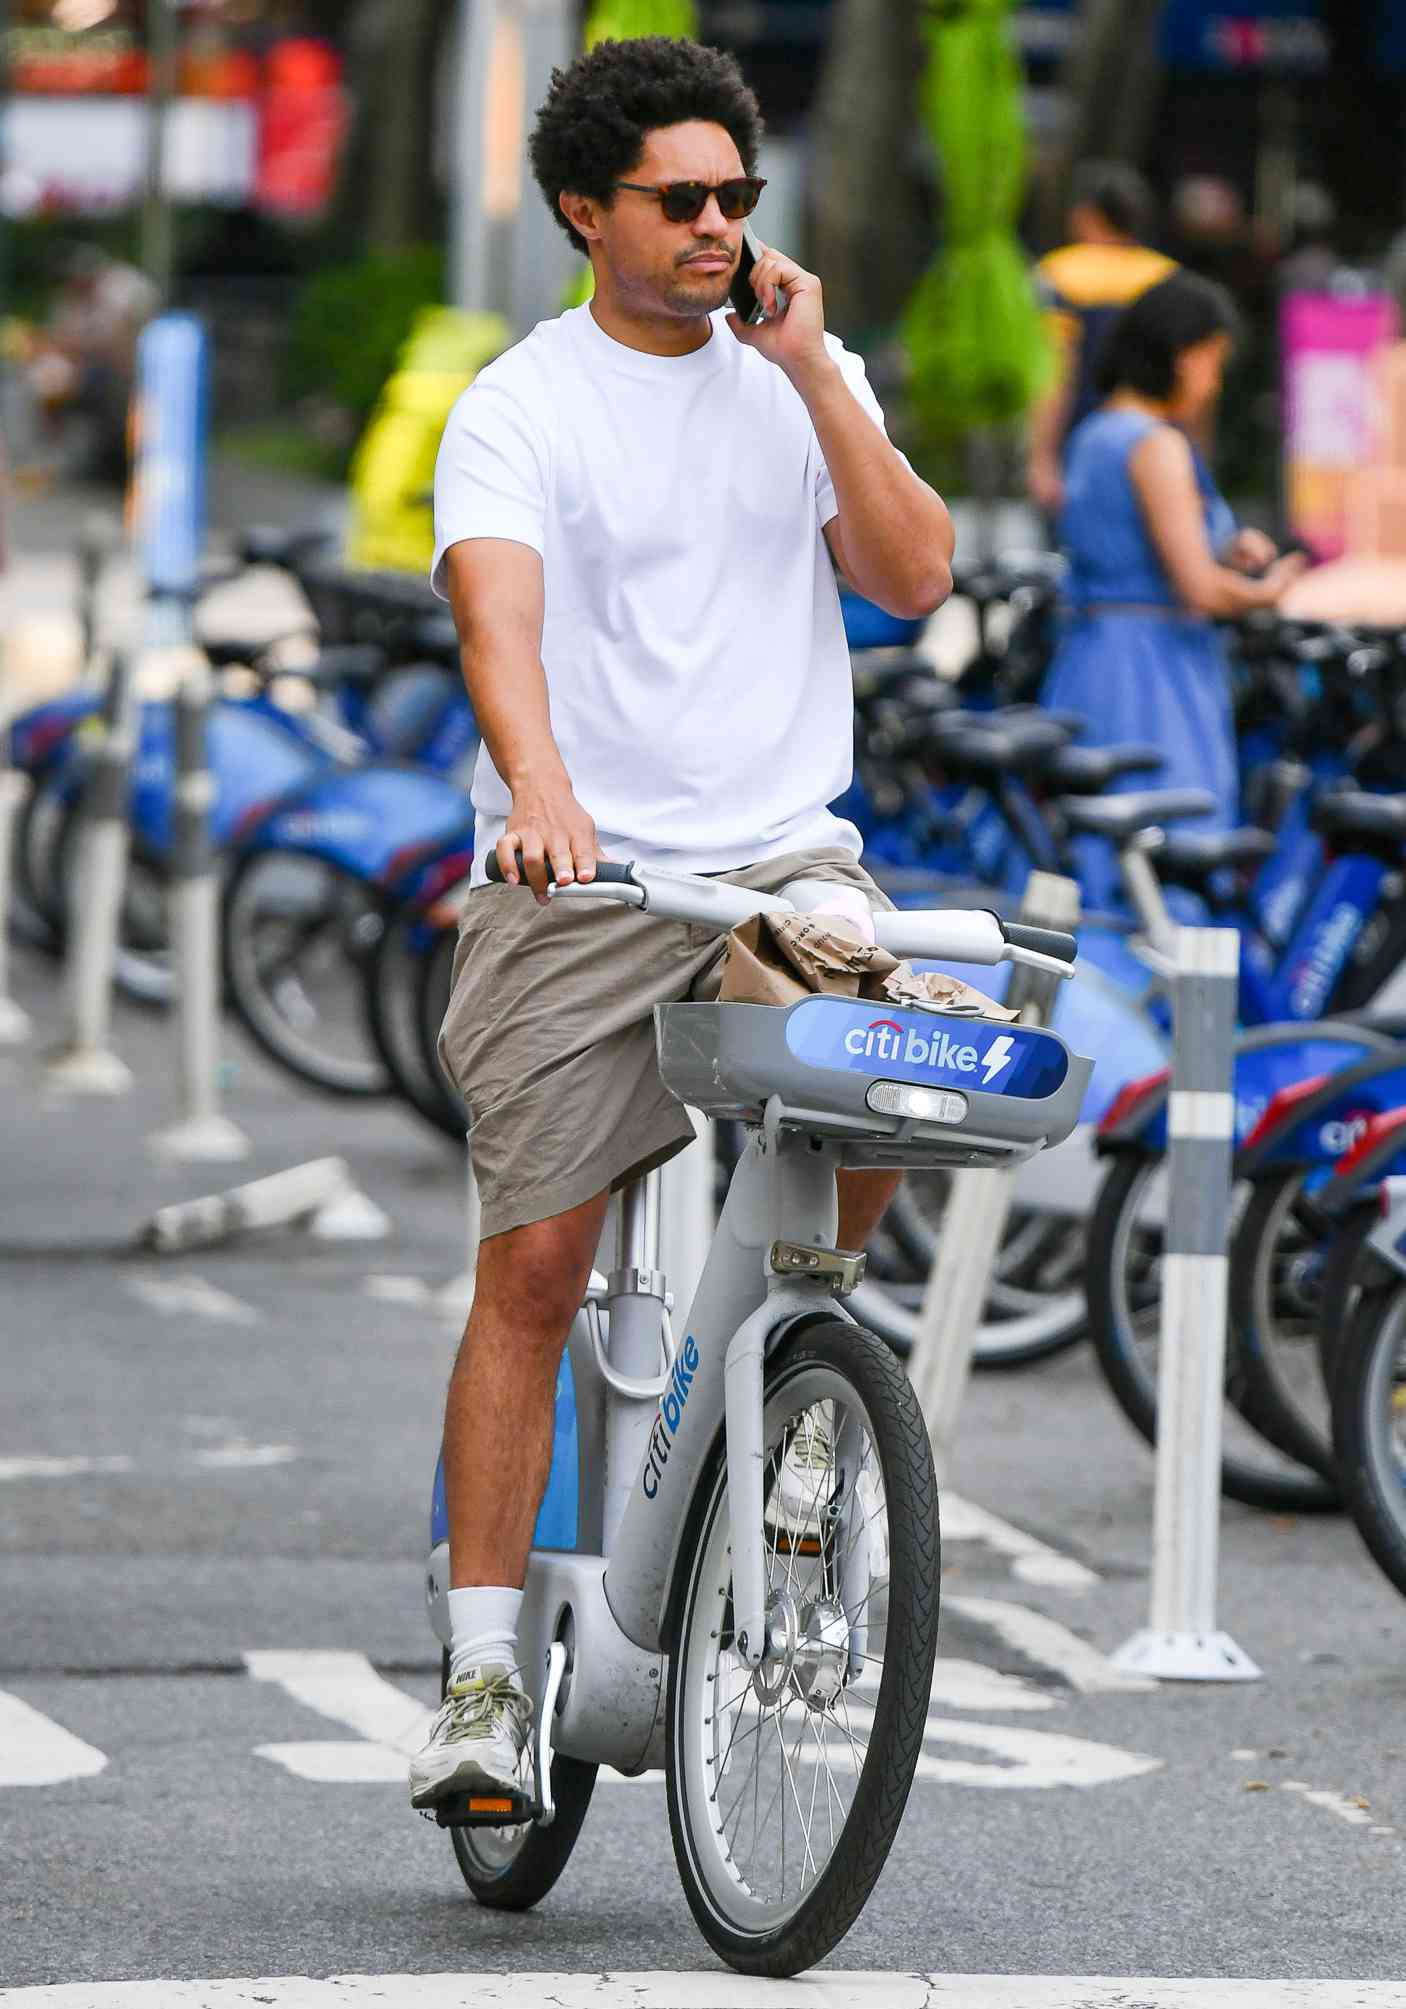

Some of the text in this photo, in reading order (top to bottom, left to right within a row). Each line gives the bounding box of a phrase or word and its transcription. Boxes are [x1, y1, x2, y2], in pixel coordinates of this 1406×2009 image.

[844, 1020, 979, 1073] citi bike
[643, 1335, 700, 1499] citi bike
[456, 1669, 477, 1684] NIKE
